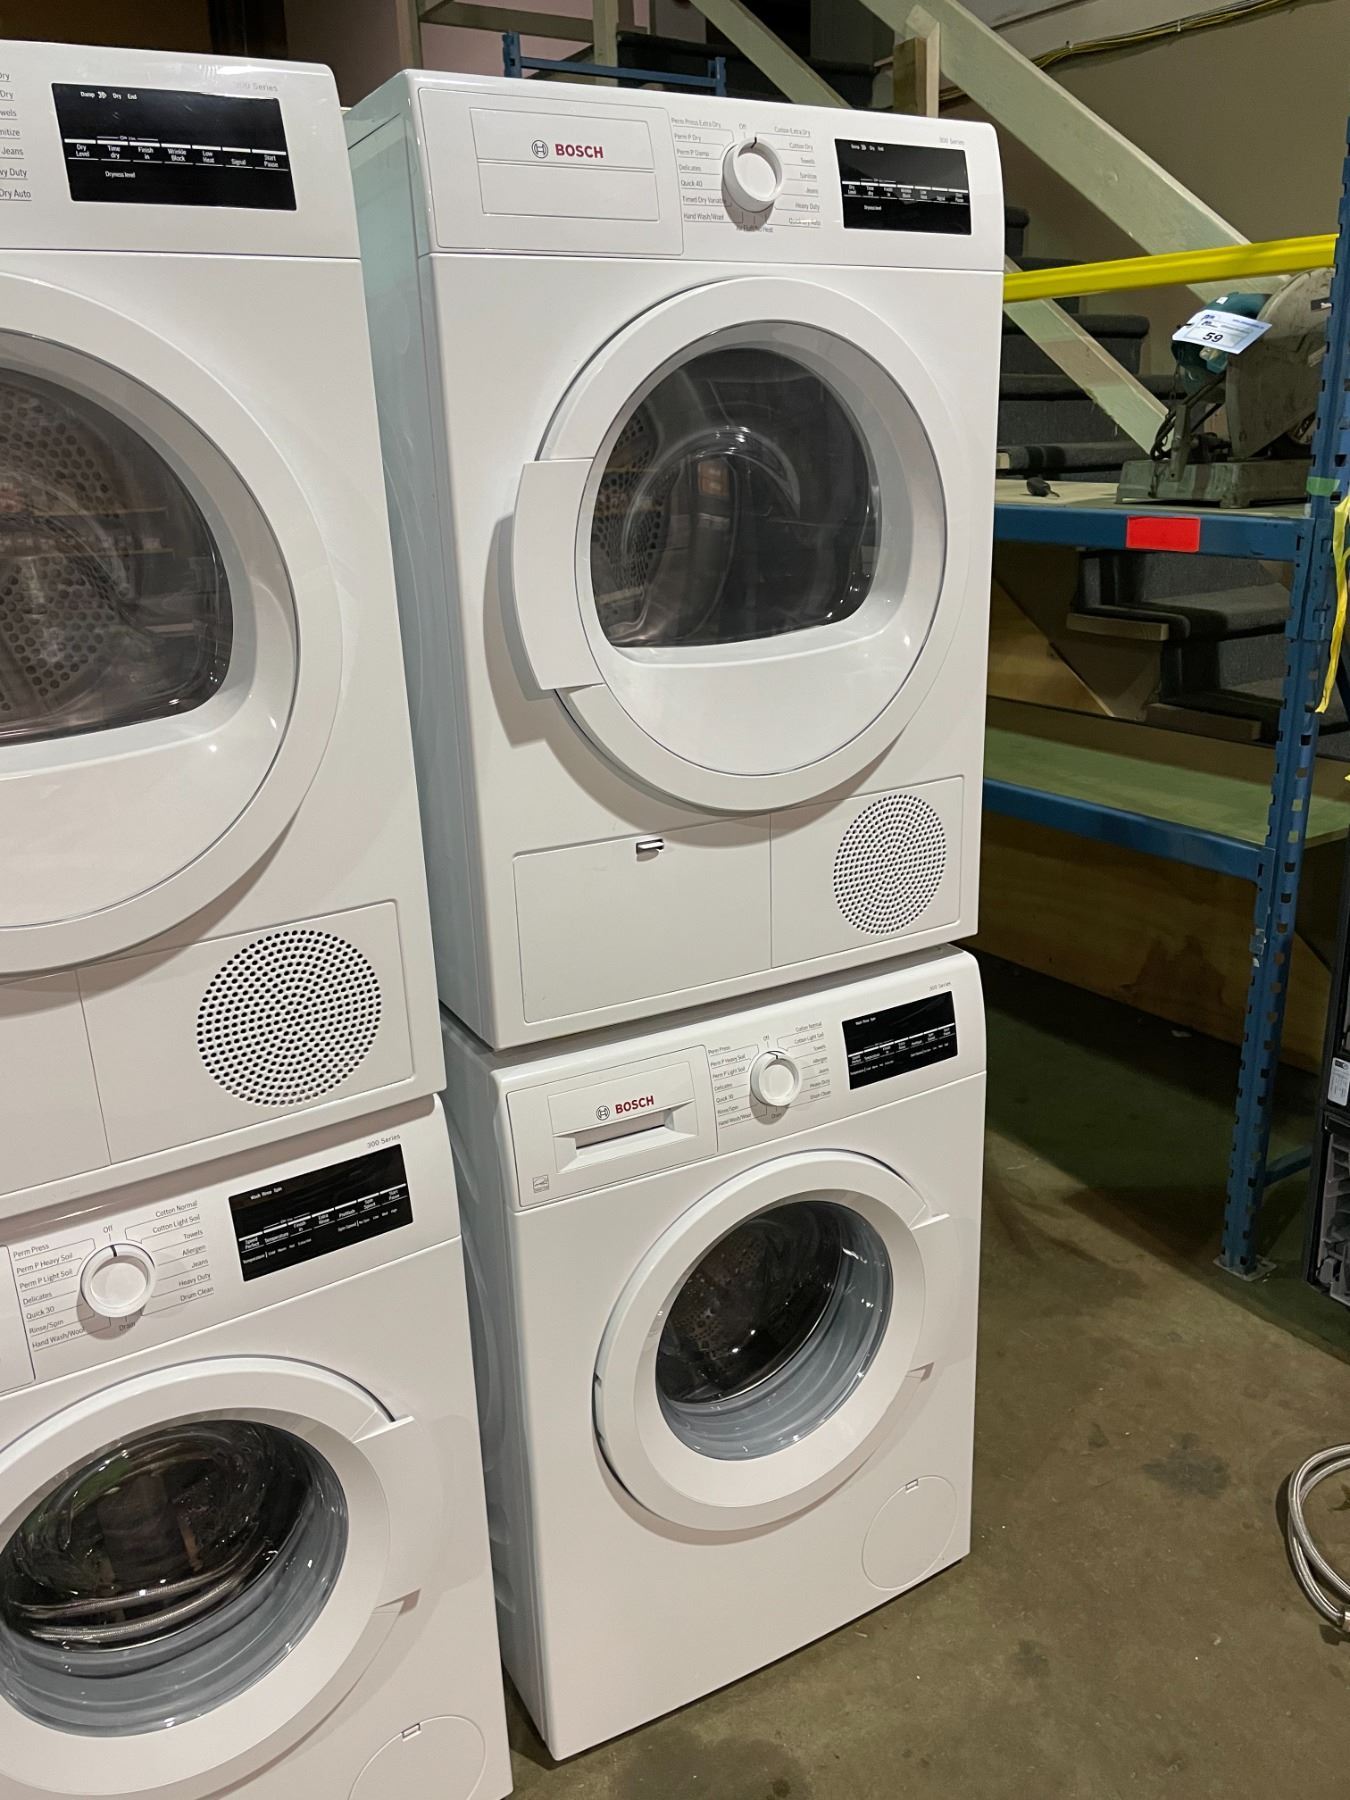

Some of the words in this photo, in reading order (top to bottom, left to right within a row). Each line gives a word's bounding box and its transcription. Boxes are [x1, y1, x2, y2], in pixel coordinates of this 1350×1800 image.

[1, 146, 24, 156] Jeans
[555, 143, 604, 158] BOSCH
[9, 168, 27, 178] Duty
[14, 189, 31, 198] Auto
[1203, 332, 1224, 343] 59
[615, 1095, 654, 1115] BOSCH
[381, 1134, 400, 1144] Series
[155, 1208, 176, 1218] Cotton
[176, 1200, 198, 1211] Normal
[103, 1225, 113, 1234] Off
[152, 1223, 173, 1234] Cotton
[173, 1218, 189, 1229] Light
[189, 1214, 200, 1223] Soil
[183, 1230, 203, 1240] Towels
[13, 1249, 31, 1258] Perm
[31, 1244, 49, 1253] Press
[182, 1244, 206, 1257] Allergen
[16, 1265, 34, 1274] Perm
[40, 1257, 60, 1267] Heavy
[191, 1259, 208, 1268] Jeans
[19, 1281, 37, 1290] Perm
[43, 1273, 59, 1283] Light
[60, 1268, 73, 1277] Soil
[178, 1276, 196, 1287] Heavy
[197, 1272, 211, 1282] Duty
[23, 1292, 52, 1305] Delicates
[180, 1292, 197, 1302] Drum
[197, 1286, 214, 1296] Clean
[26, 1309, 45, 1320] Quick
[45, 1305, 55, 1314] 30
[29, 1319, 64, 1334] Rinse/Spin
[119, 1321, 136, 1331] Drain
[32, 1338, 49, 1348] Hand
[50, 1327, 86, 1343] Wash/Wool
